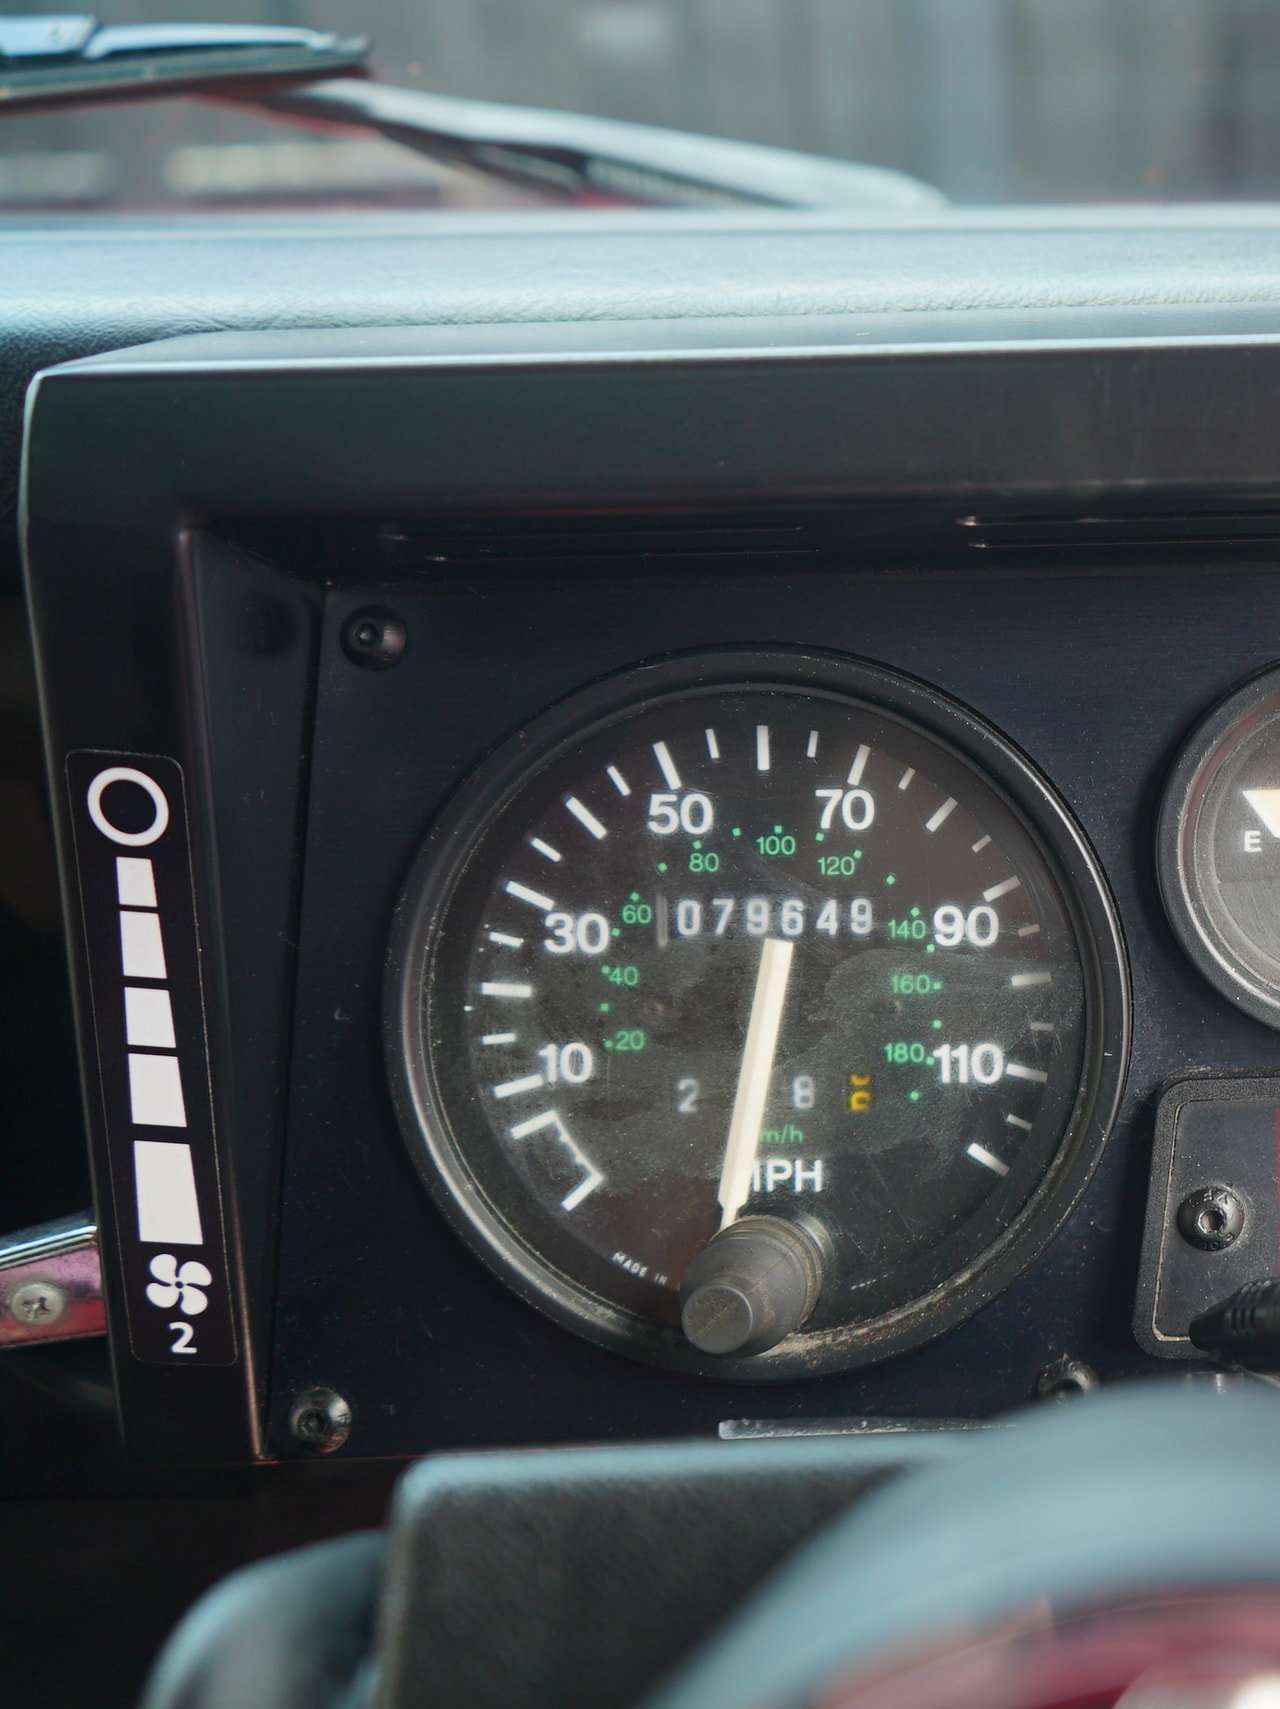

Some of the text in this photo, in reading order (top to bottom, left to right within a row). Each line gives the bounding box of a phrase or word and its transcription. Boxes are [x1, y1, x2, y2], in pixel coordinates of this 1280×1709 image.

[649, 794, 713, 834] 50
[815, 789, 875, 830] 70
[756, 836, 796, 855] 100
[1243, 829, 1262, 853] E
[689, 853, 720, 872] 80
[817, 856, 856, 876] 120
[622, 904, 652, 924] 60
[677, 897, 873, 936] 079649
[933, 905, 999, 947] 90
[544, 912, 610, 953] 30
[888, 919, 926, 940] 140
[609, 966, 640, 986] 40
[890, 974, 931, 994] 160
[615, 1030, 646, 1050] 20
[538, 1042, 594, 1083] 10
[884, 1042, 926, 1064] 180
[933, 1043, 1003, 1085] 110
[759, 1124, 803, 1144] m/h
[753, 1158, 823, 1193] PH
[612, 1251, 648, 1278] MADE
[168, 1321, 198, 1355] 2
